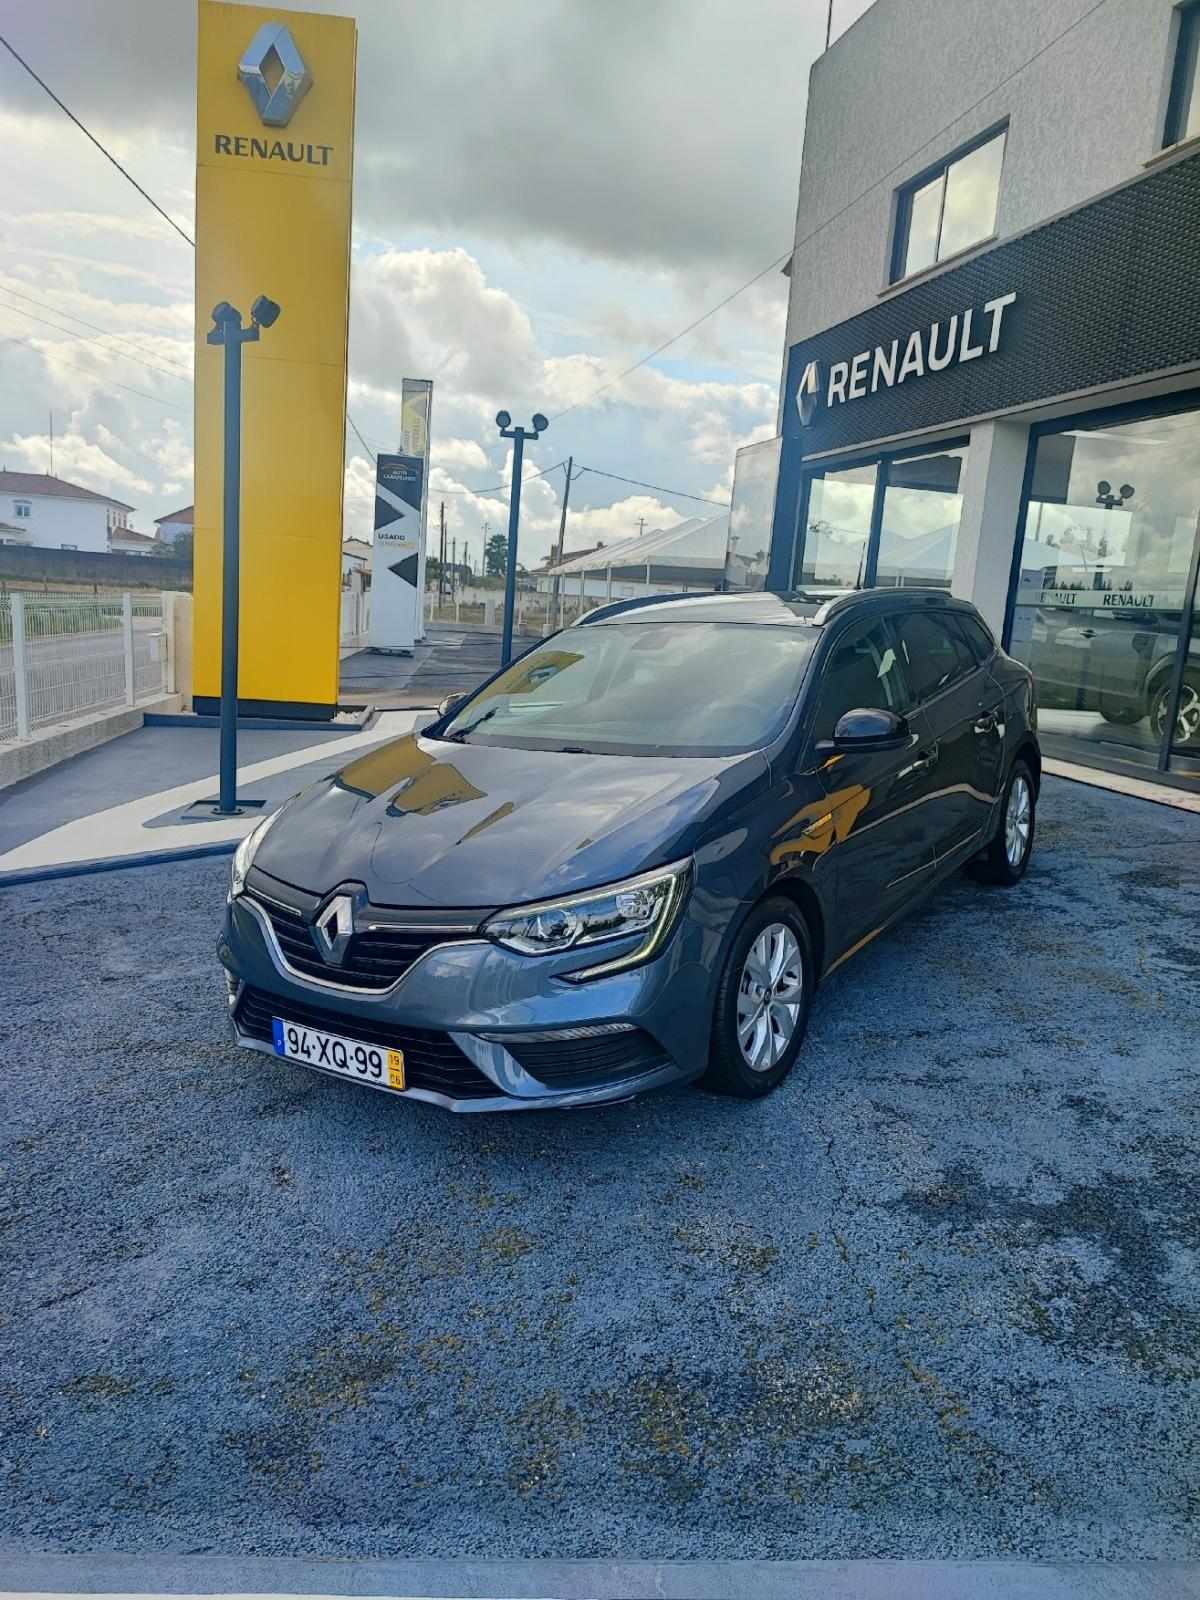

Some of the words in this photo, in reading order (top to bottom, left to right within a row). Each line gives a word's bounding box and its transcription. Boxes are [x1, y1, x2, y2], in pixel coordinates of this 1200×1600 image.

[215, 134, 335, 166] RENAULT
[827, 291, 1017, 408] RENAULT
[1103, 593, 1154, 608] RENAULT
[390, 1054, 400, 1066] 19
